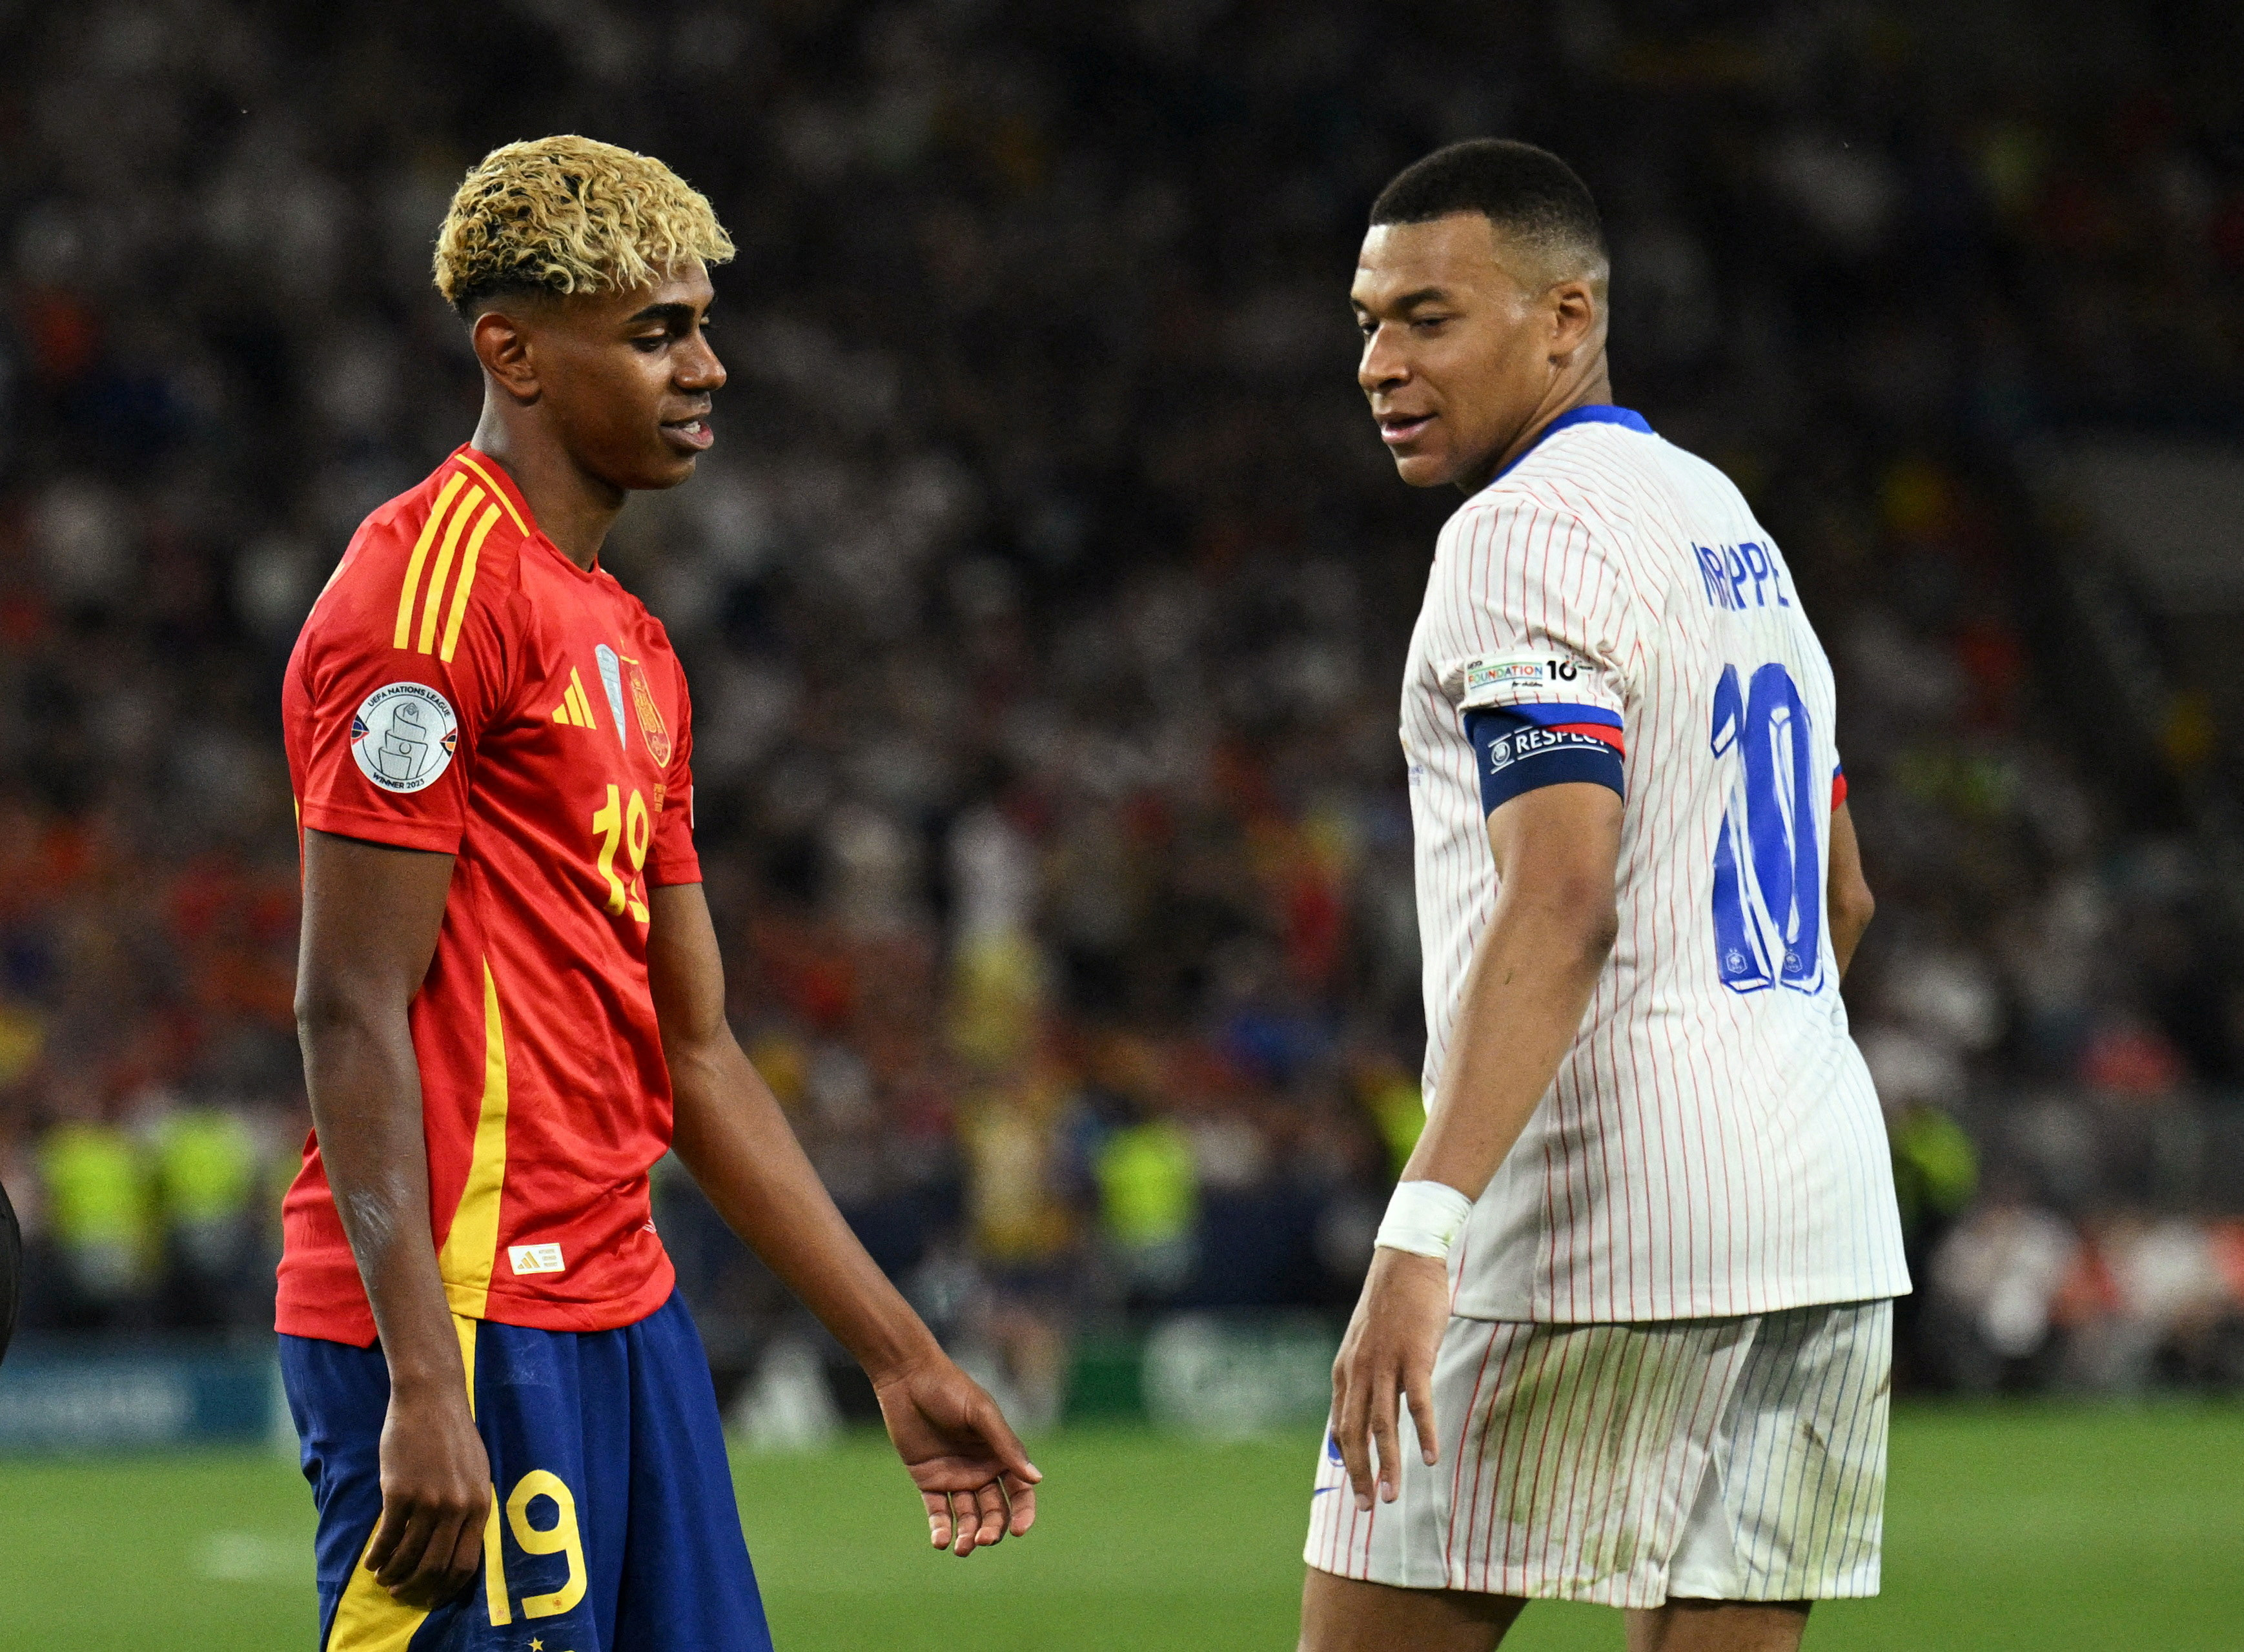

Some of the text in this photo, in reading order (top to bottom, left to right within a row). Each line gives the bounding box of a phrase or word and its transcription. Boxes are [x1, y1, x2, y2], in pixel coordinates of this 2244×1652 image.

[1468, 666, 1542, 683] FOUNDATION
[1547, 659, 1577, 682] 10
[367, 686, 451, 717] UEFA NATIONS LEAGUE
[1516, 728, 1605, 754] RESPE
[372, 772, 425, 789] WINNER 2023
[1711, 662, 1824, 996] 10
[593, 784, 650, 924] 19
[483, 1469, 588, 1627] 19
